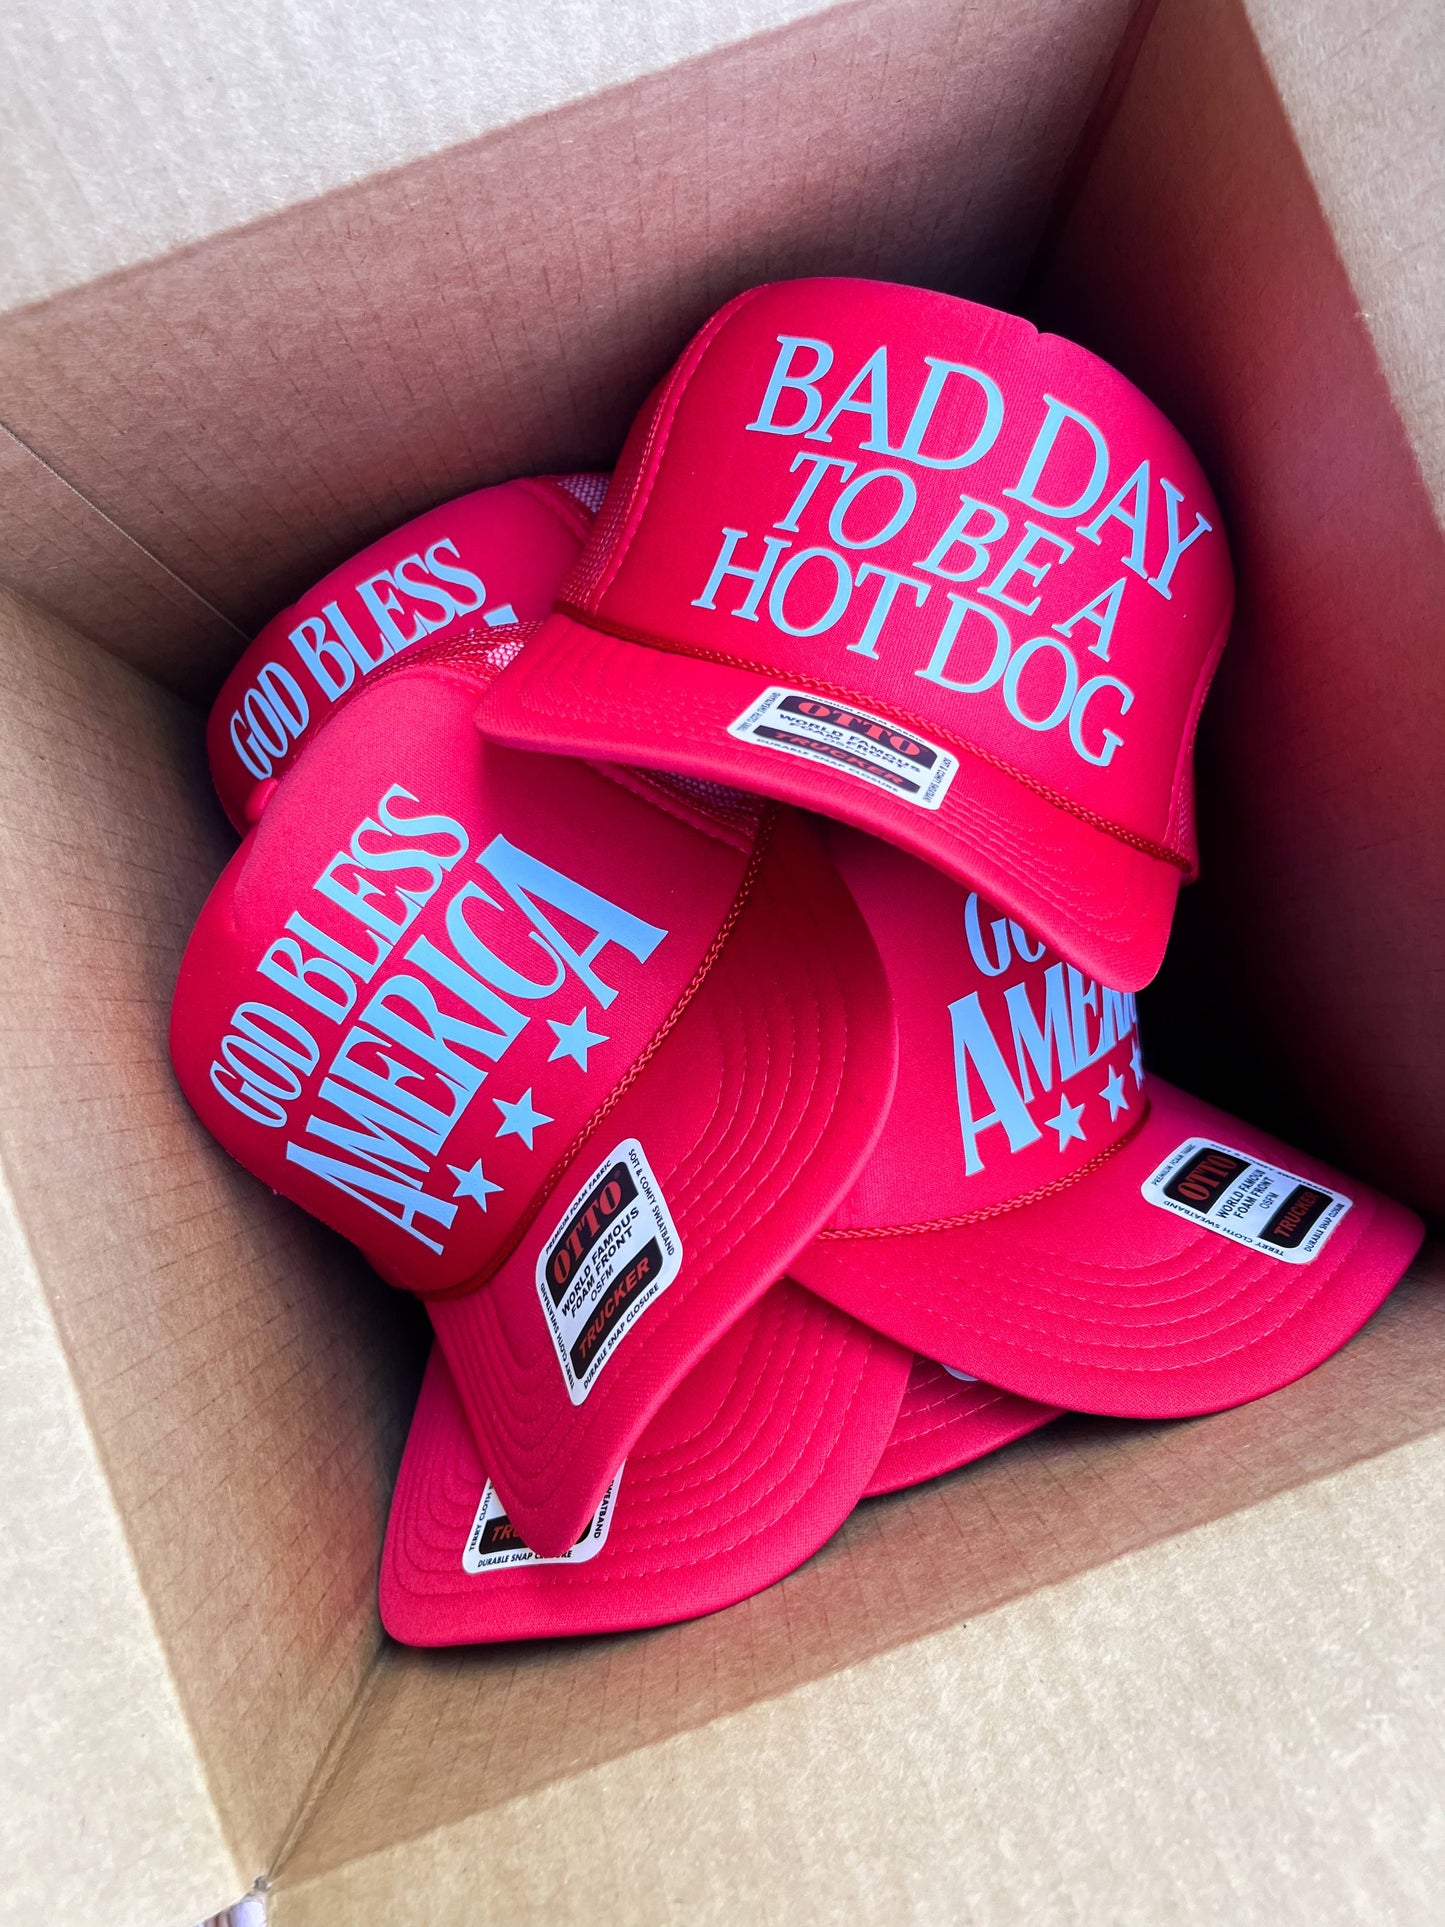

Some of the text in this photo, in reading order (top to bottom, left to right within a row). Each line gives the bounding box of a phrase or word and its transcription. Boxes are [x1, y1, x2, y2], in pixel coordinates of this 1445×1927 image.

[745, 334, 1213, 600] BAD DAY
[773, 451, 1127, 662] TO BE A
[230, 537, 487, 780] GOD BLESS
[691, 527, 1135, 767] HOT DOG
[776, 732, 904, 784] TRUCKER
[780, 713, 921, 773] WORLD FAMOUS
[789, 722, 906, 768] FOAM FRONT
[798, 701, 920, 756] OTTO
[209, 783, 470, 1128] GOD BLESS
[285, 833, 669, 1256] AMERICA
[545, 1159, 612, 1255] PREMIUM FOAM FABRIC
[628, 1148, 675, 1256] SOFT & COMFY SWEATBAND
[1163, 1200, 1221, 1229] SWEATBAND
[1177, 1154, 1237, 1200] OTTO
[1216, 1189, 1244, 1219] WORLD
[1233, 1176, 1275, 1219] FOAM FRONT
[1273, 1191, 1321, 1238] TRUCKER
[553, 1181, 622, 1285] OTTO
[561, 1206, 640, 1317] WORLD FAMOUS
[1222, 1227, 1253, 1243] CLOTH
[570, 1225, 633, 1319] FOAM FRONT
[578, 1256, 651, 1360] TRUCKER
[590, 1263, 614, 1302] OSFM
[583, 1283, 660, 1390] DURABLE SNAP CLOSURE
[468, 1524, 482, 1552] TERRY
[479, 1492, 492, 1521] CLOTH
[477, 1554, 510, 1568] DURABLE
[511, 1551, 533, 1562] SNAP
